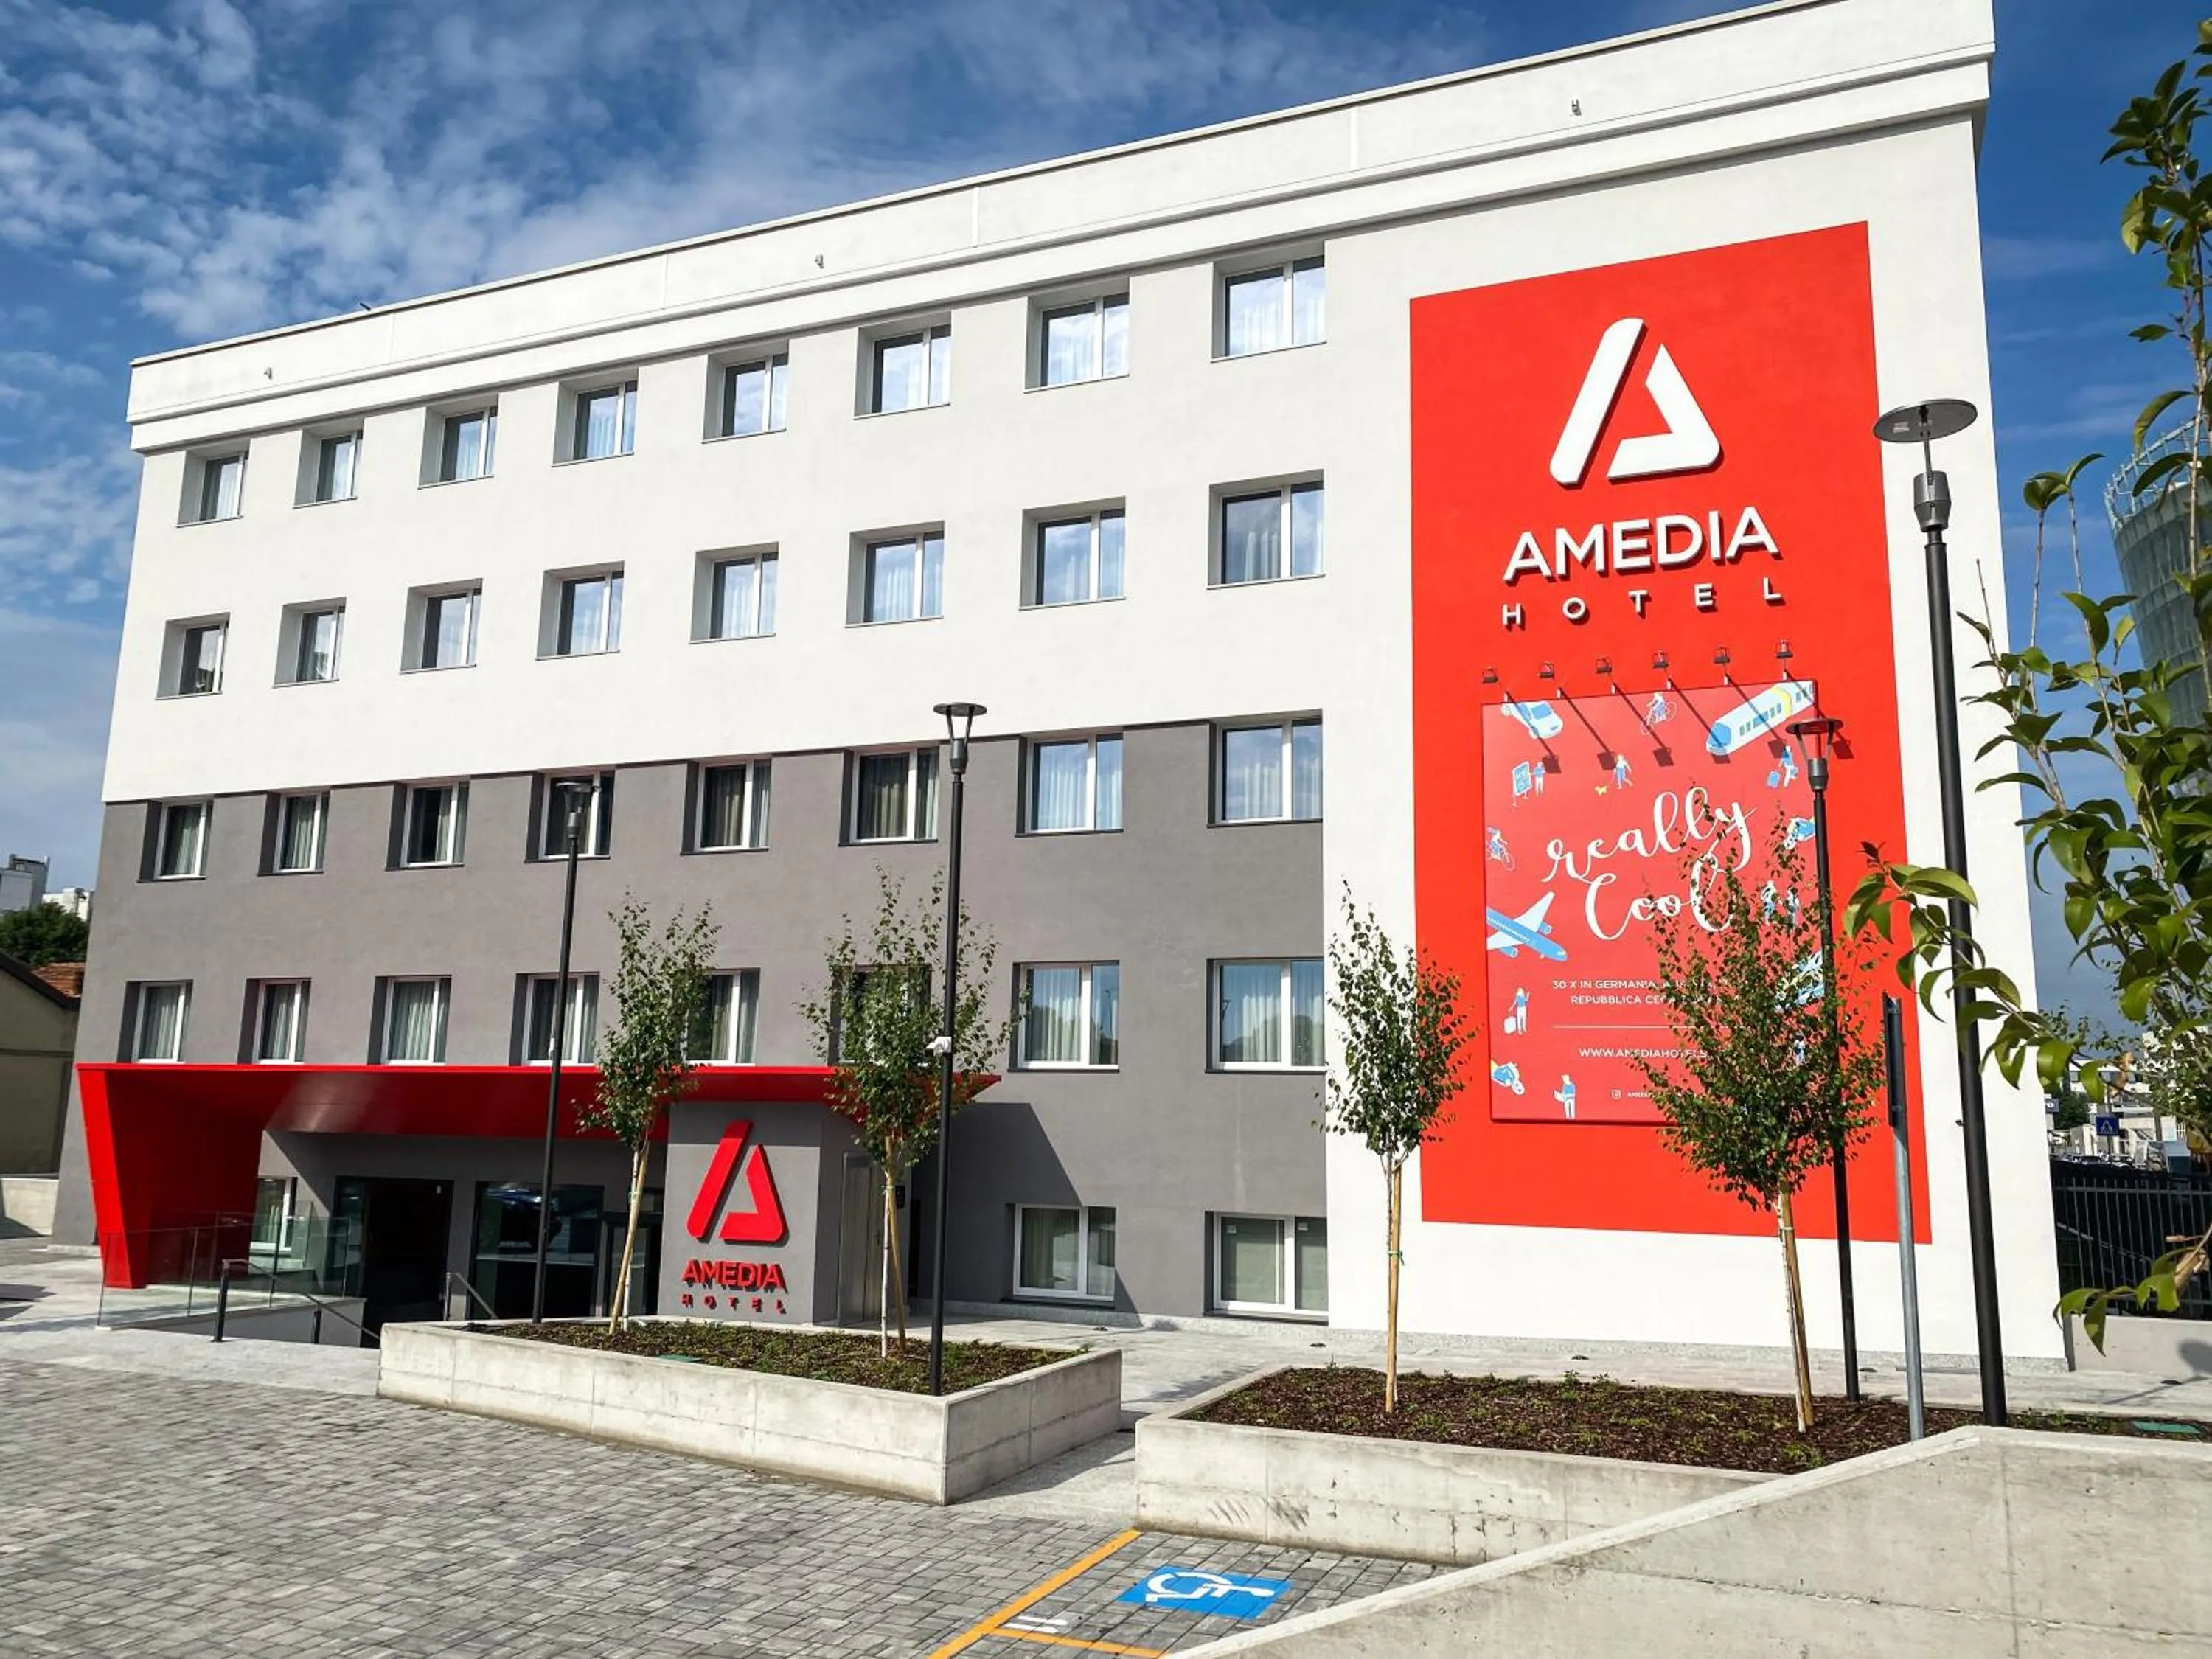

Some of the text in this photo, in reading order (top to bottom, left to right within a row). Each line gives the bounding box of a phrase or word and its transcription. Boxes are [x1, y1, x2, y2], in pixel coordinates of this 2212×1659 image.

[1503, 507, 1780, 582] AMEDIA
[1502, 577, 1782, 627] HOTEL
[1542, 787, 1756, 883] really
[1551, 980, 1567, 989] 30
[1570, 980, 1577, 989] X
[1579, 980, 1592, 989] IN
[1571, 995, 1641, 1004] REPUBBLICA
[681, 1259, 787, 1293] AMEDIA
[682, 1293, 787, 1315] HOTEL
